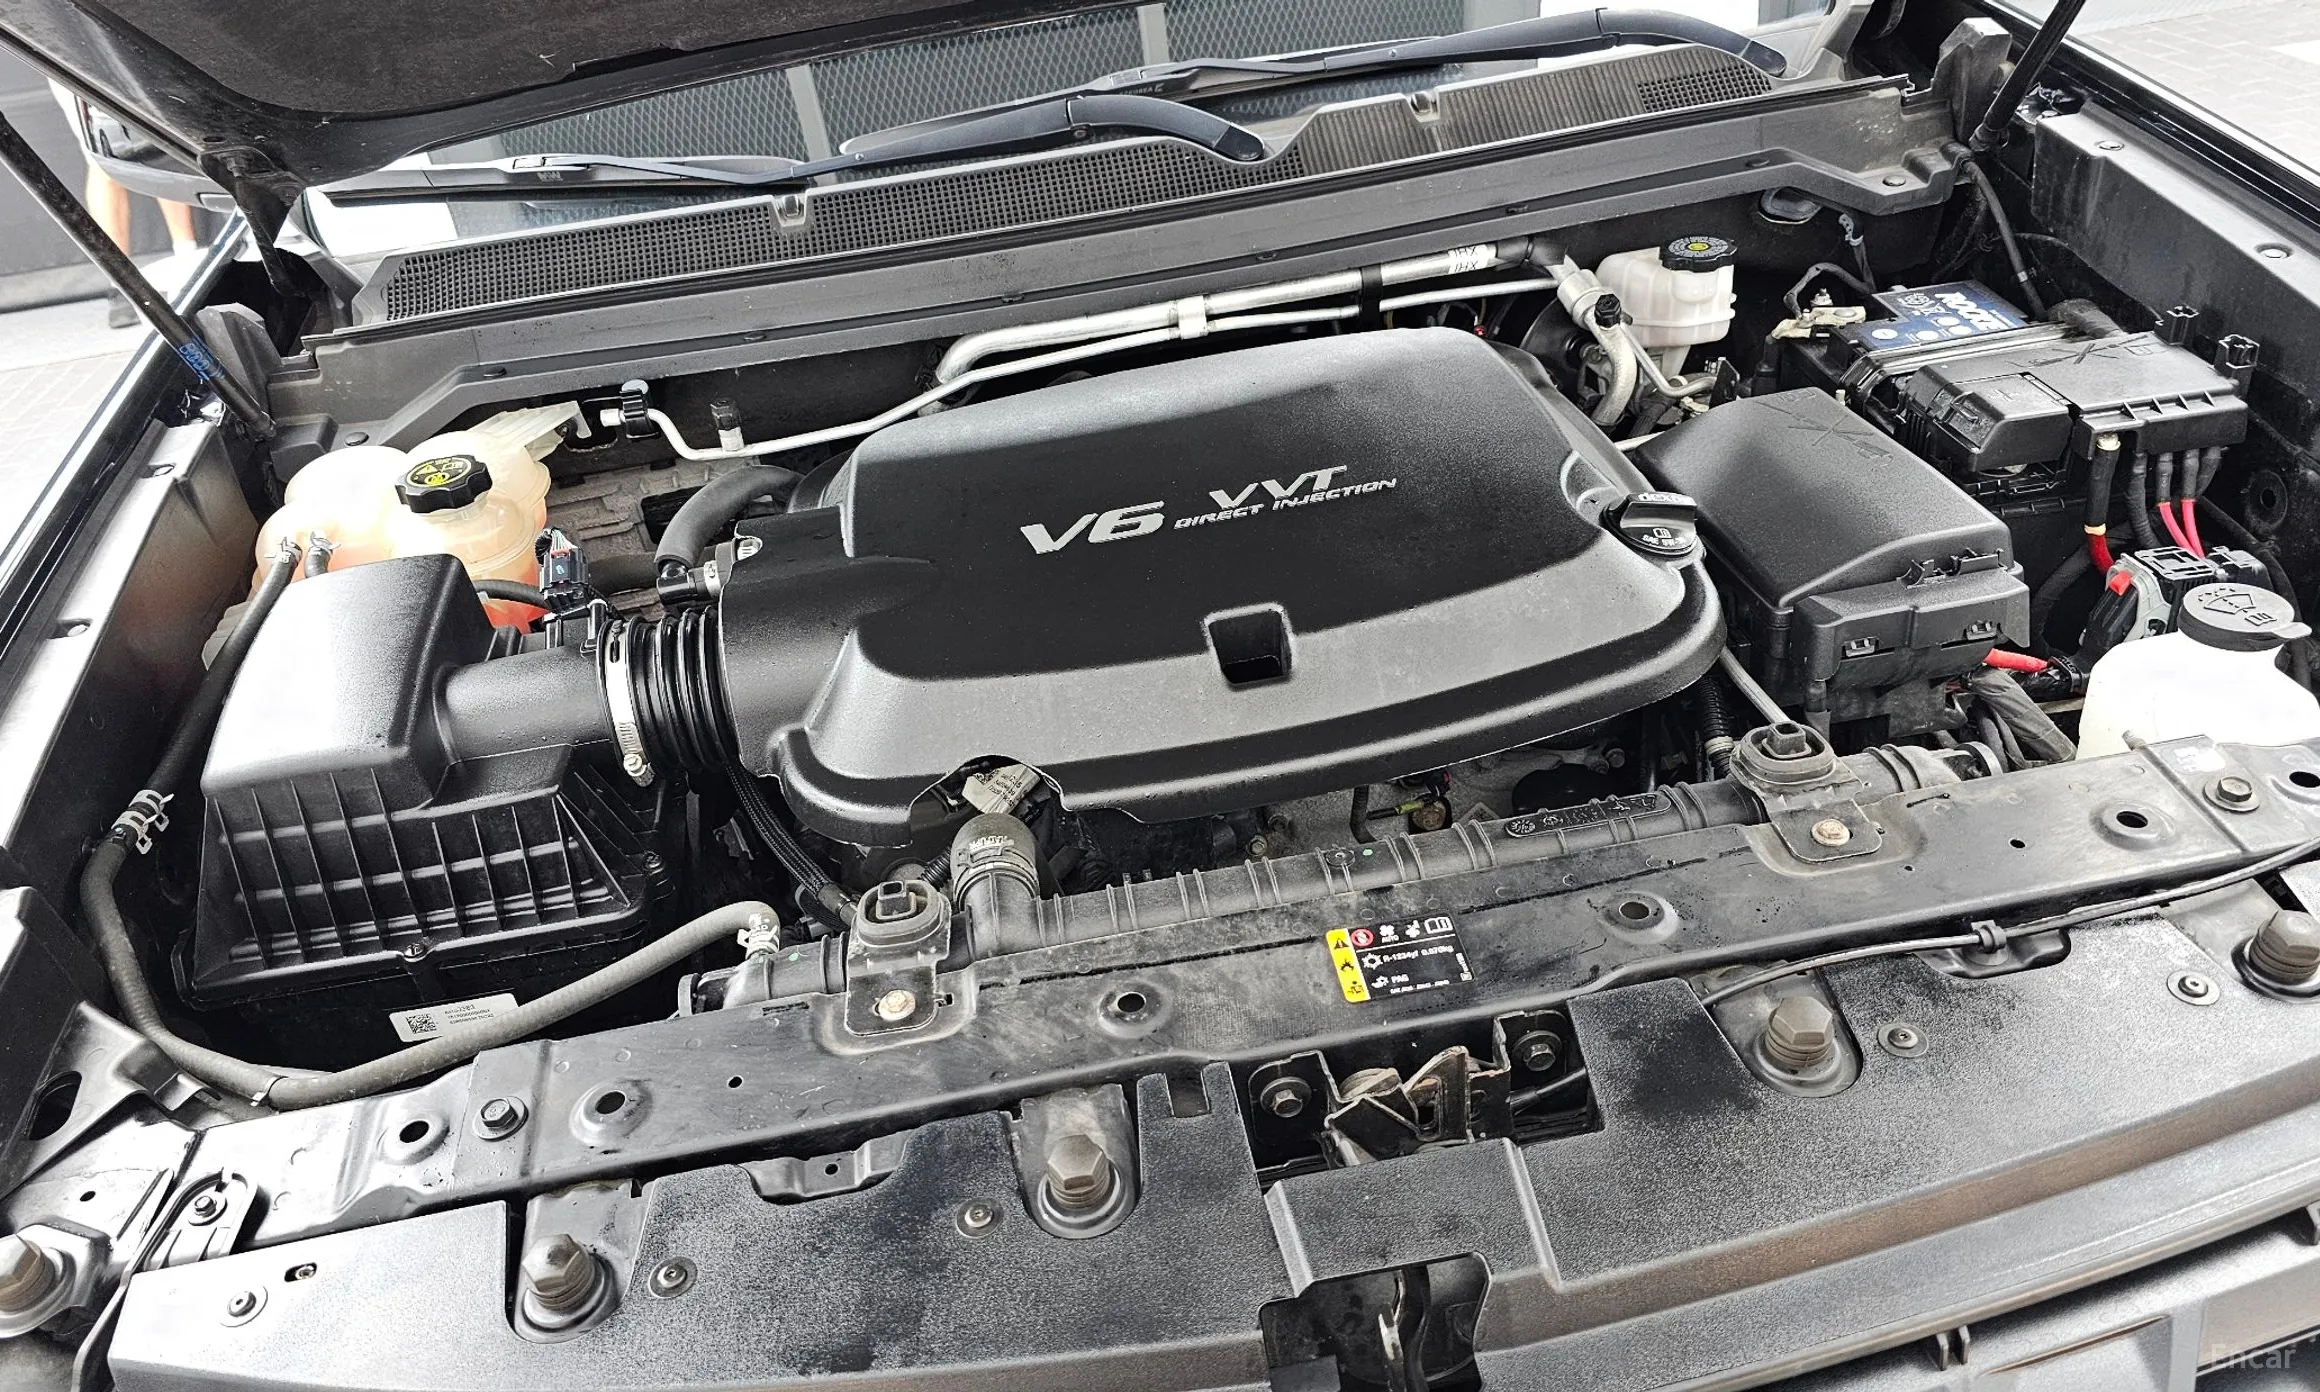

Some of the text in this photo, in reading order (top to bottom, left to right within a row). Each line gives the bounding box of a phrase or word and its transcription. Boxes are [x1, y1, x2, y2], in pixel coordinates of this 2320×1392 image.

[1209, 465, 1348, 510] VVT
[1174, 478, 1397, 529] DIRECT INJECTION
[1020, 501, 1165, 554] V6
[1381, 934, 1400, 943] AUTO
[1382, 949, 1419, 963] R-1234yf
[1390, 973, 1410, 984] PAG
